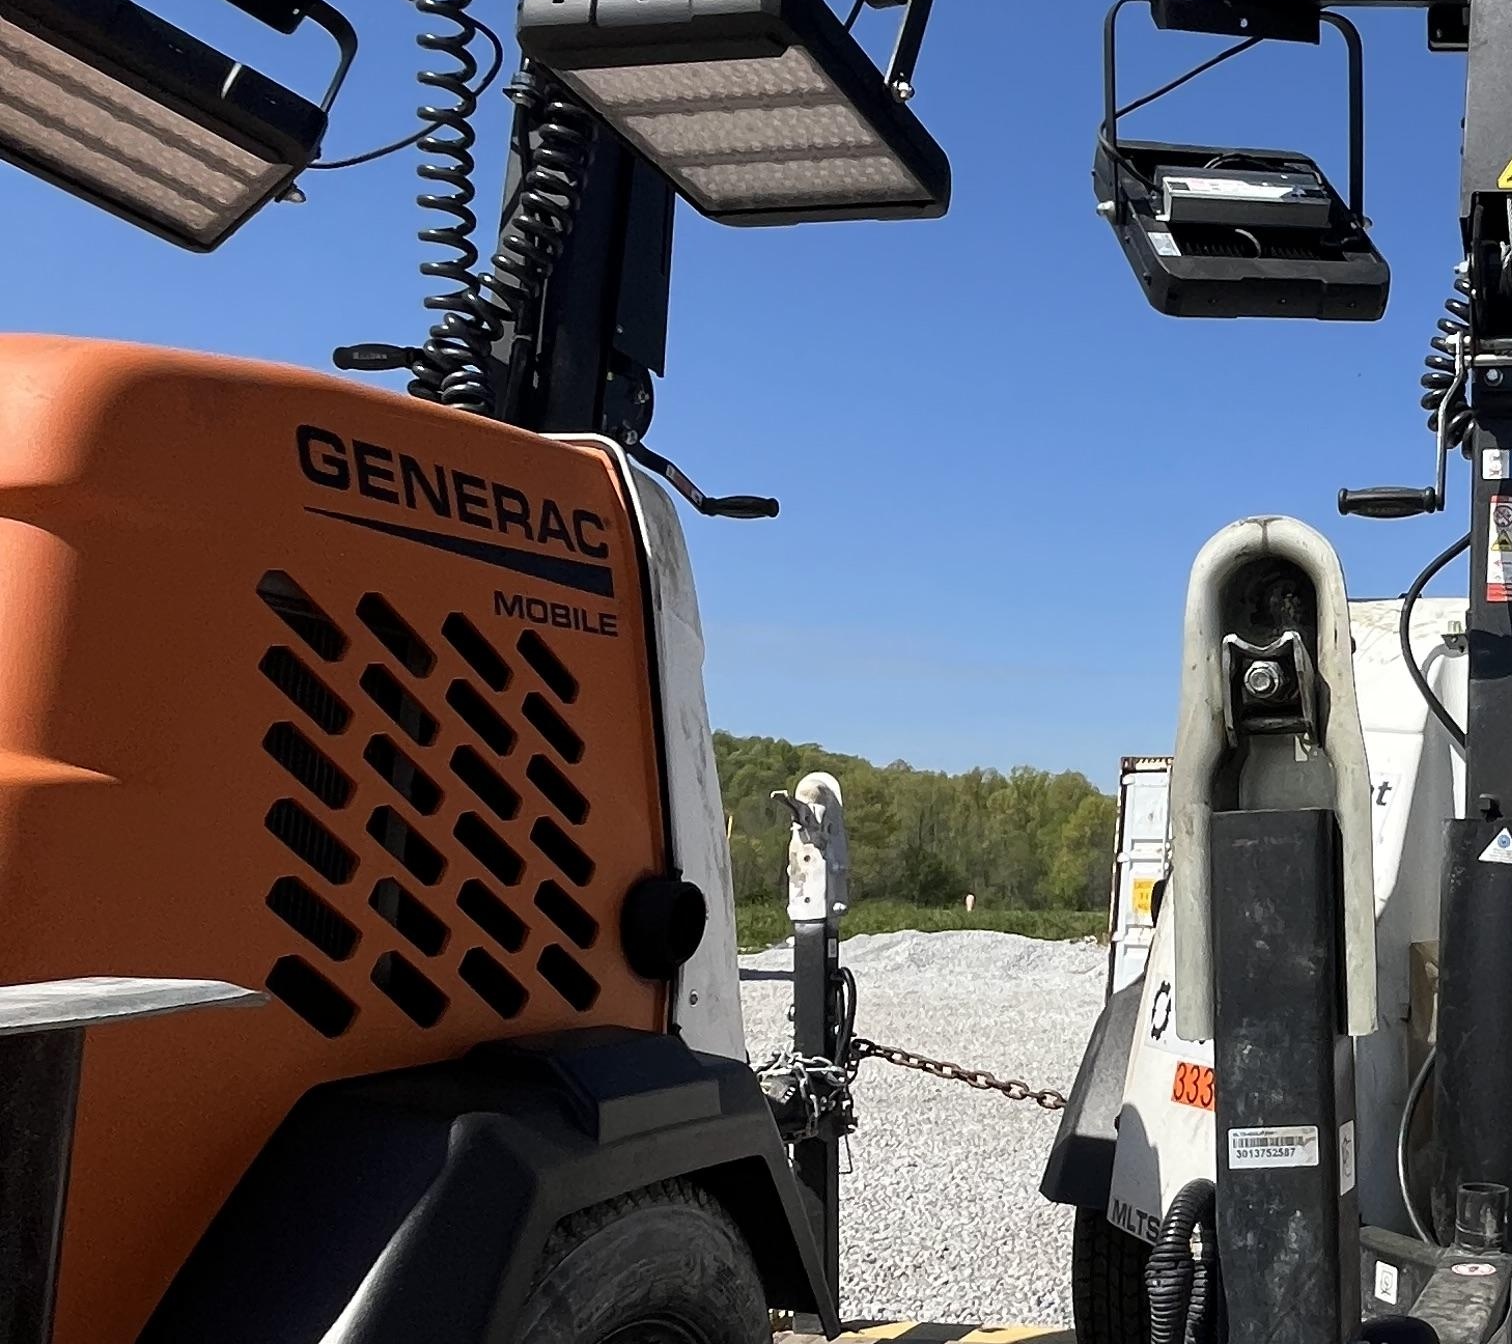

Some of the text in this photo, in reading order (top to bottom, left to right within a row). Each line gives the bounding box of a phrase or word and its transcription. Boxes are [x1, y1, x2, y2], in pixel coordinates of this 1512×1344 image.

[295, 423, 610, 560] GENERAC
[493, 590, 618, 637] MOBILE
[1173, 1062, 1215, 1108] 333
[1111, 1199, 1161, 1243] MLTS
